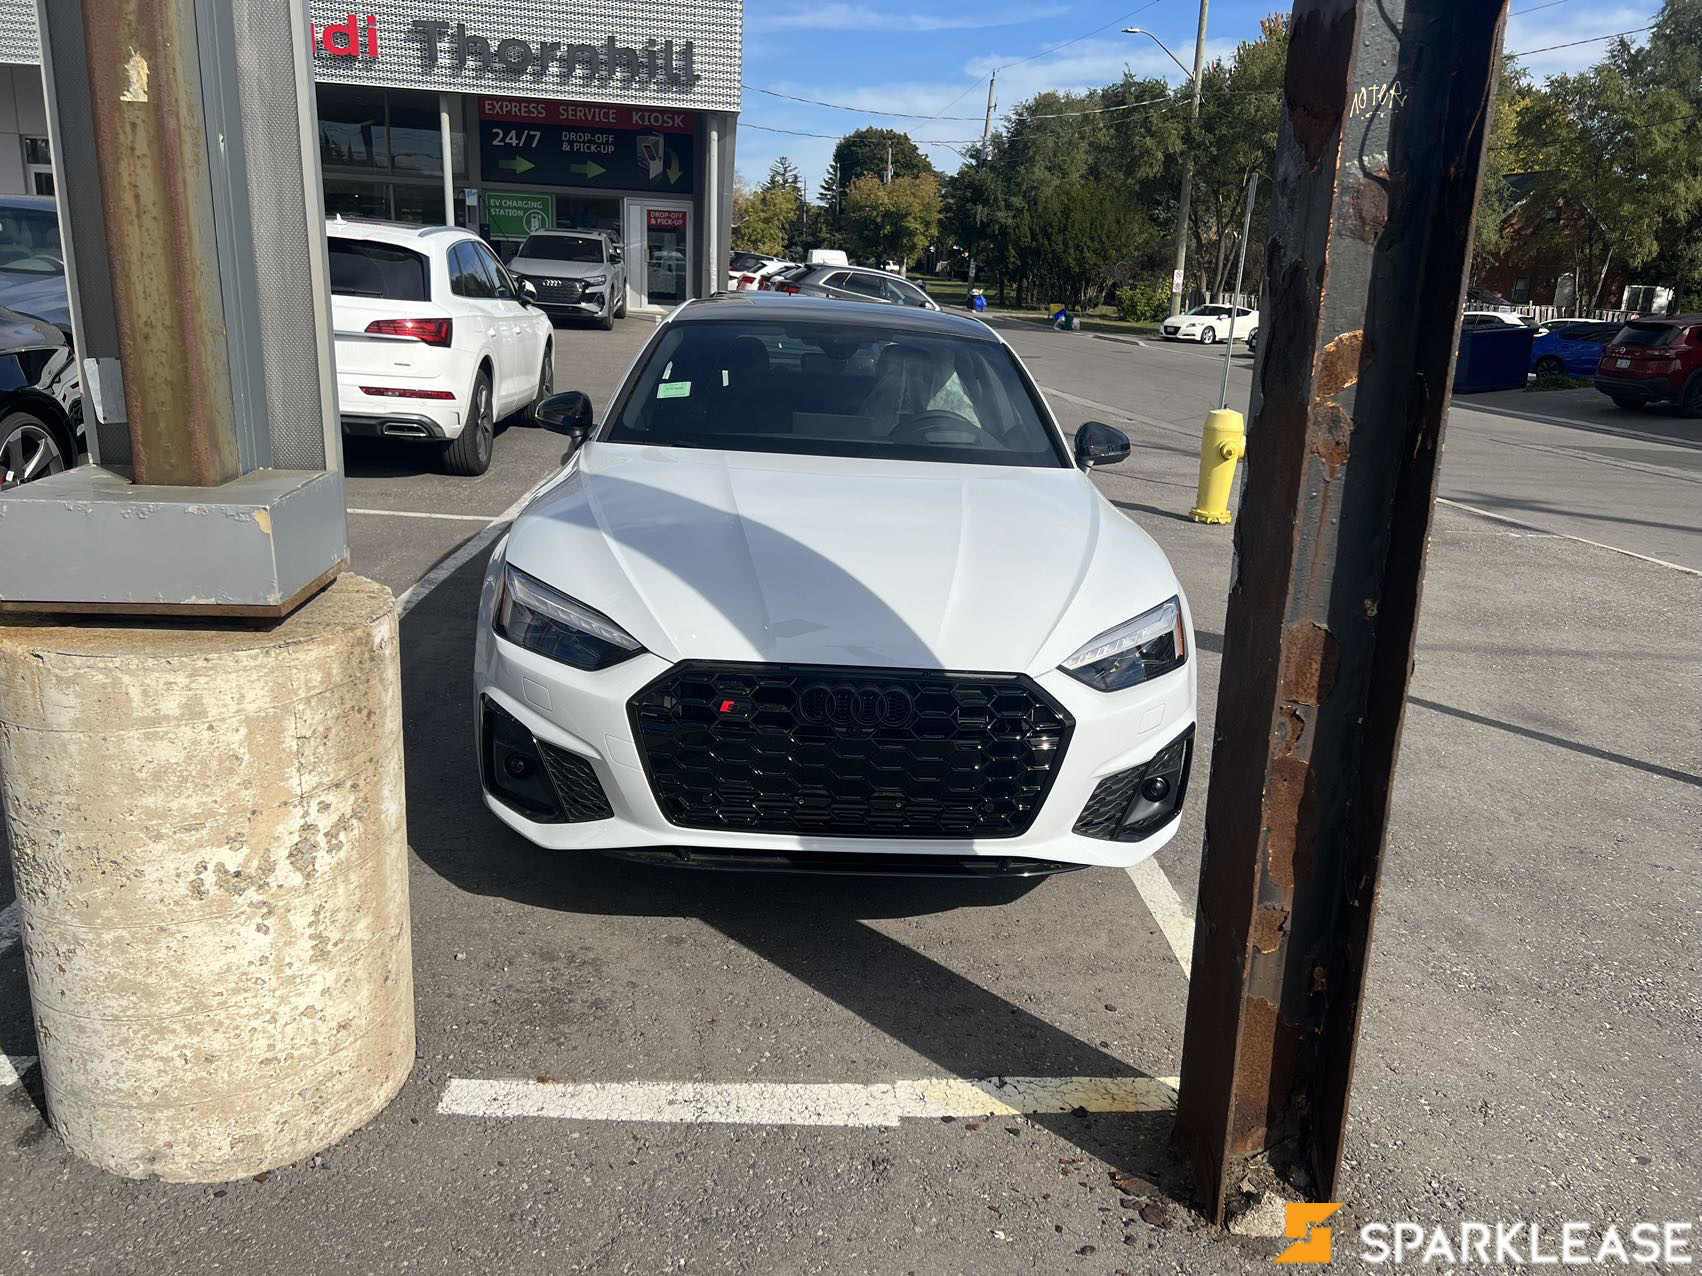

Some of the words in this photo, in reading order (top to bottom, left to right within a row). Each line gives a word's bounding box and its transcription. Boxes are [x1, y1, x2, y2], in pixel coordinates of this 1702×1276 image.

[311, 15, 379, 58] di
[412, 20, 699, 83] Thornhill
[484, 100, 546, 118] EXPRESS
[559, 105, 617, 123] SERVICE
[632, 111, 685, 128] KIOSK
[491, 128, 542, 149] 24/7
[561, 131, 615, 143] DROP-OFF
[561, 141, 570, 151] &
[573, 142, 615, 155] PICK-UP
[490, 199, 501, 207] EV
[501, 199, 543, 209] CHARGING
[490, 208, 524, 217] STATION
